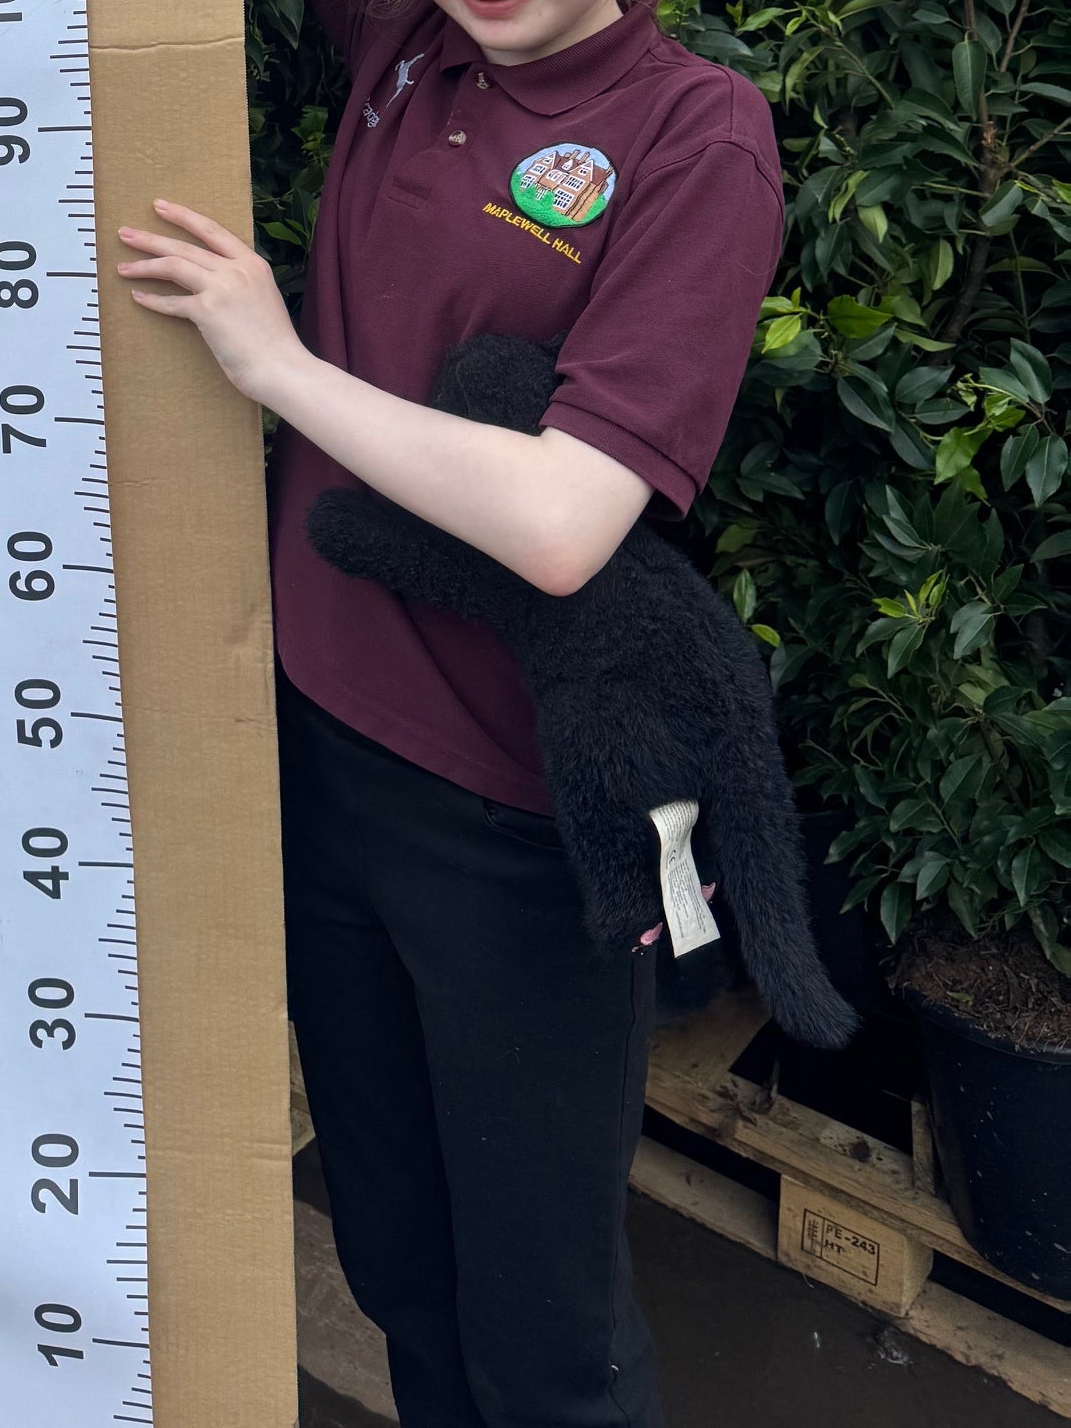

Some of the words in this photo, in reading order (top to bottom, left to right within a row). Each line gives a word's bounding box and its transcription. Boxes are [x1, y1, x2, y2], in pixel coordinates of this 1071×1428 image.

[482, 203, 550, 244] MAPLEWELL
[551, 238, 581, 264] HALL
[0, 386, 46, 453] 70
[7, 532, 54, 600] 60
[15, 679, 62, 748] 50
[22, 828, 69, 899] 40
[28, 978, 75, 1050] 30
[31, 1134, 78, 1214] 20
[34, 1304, 83, 1366] 10
